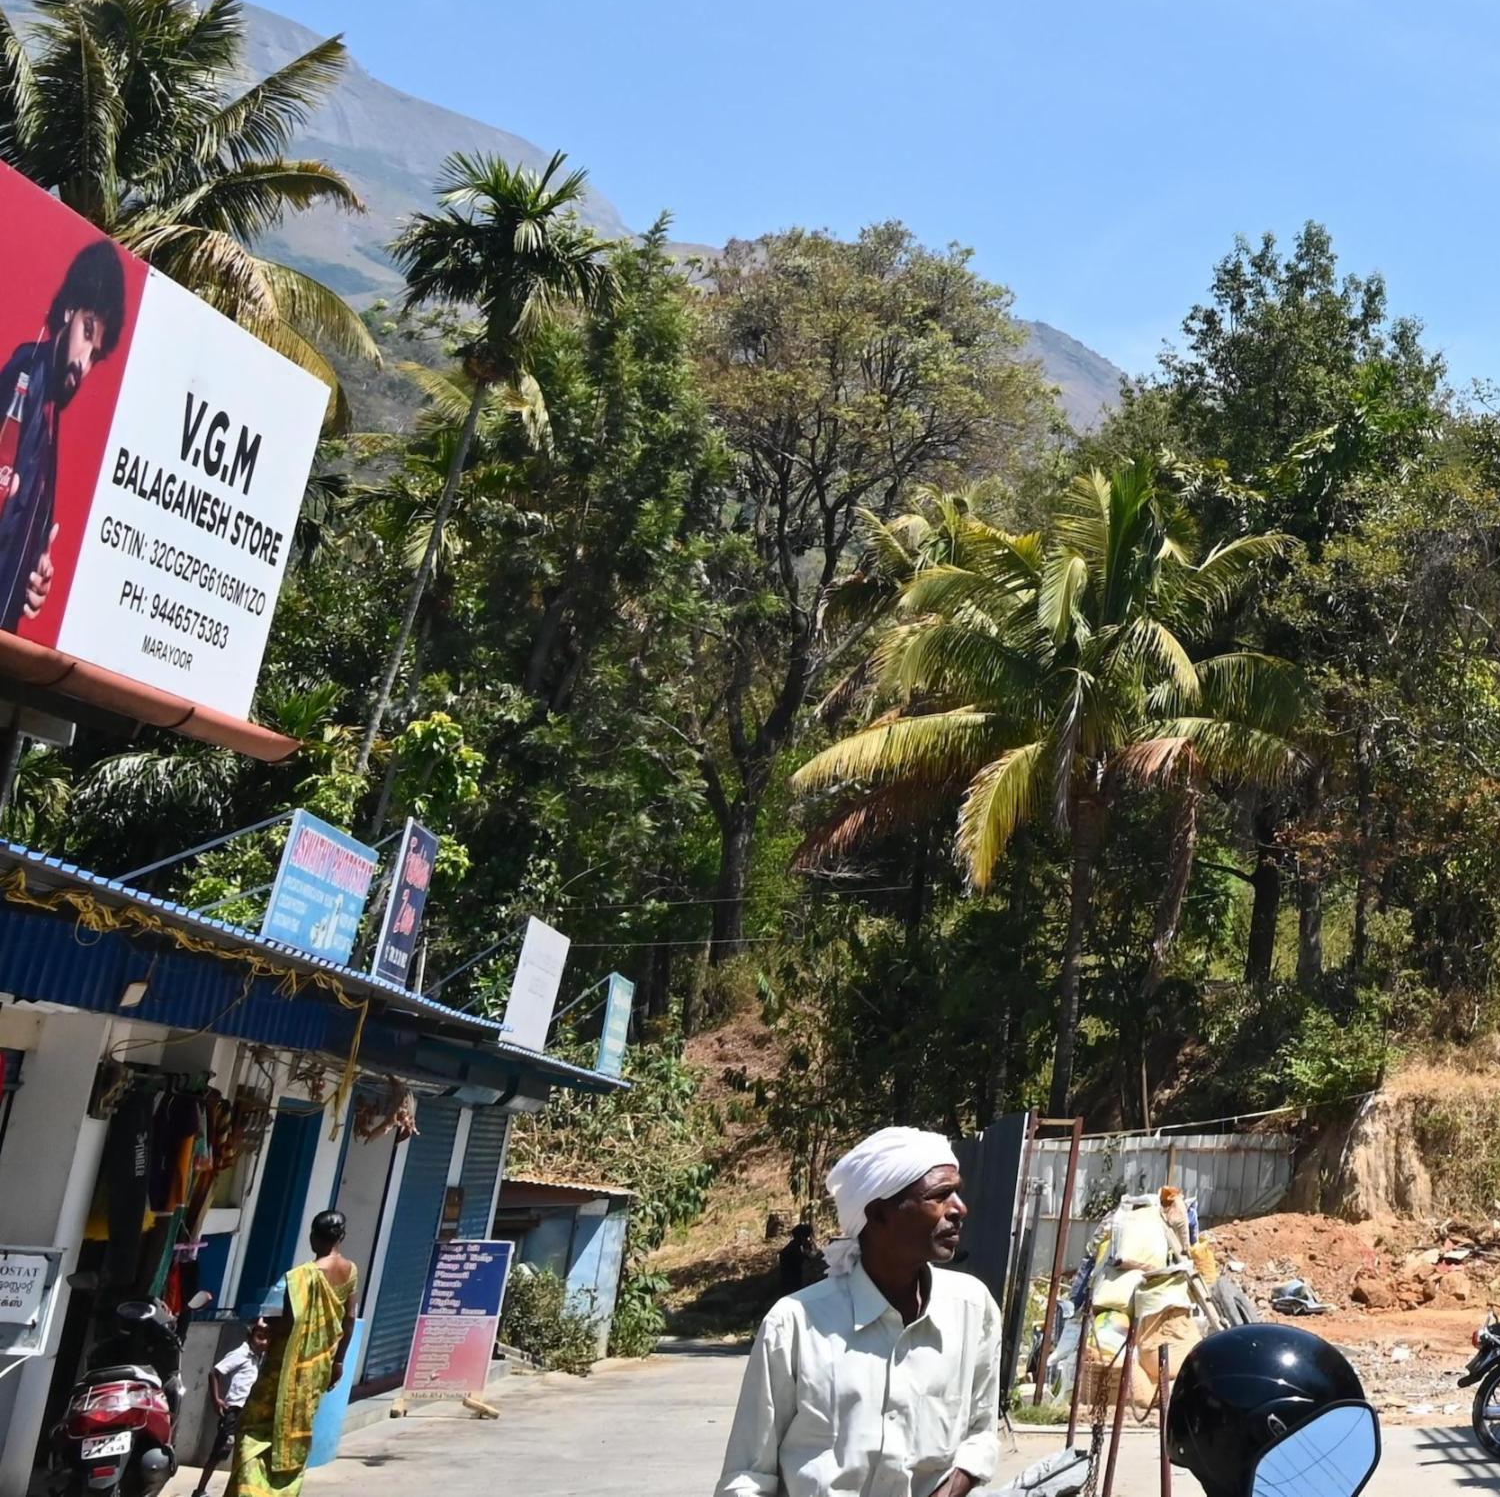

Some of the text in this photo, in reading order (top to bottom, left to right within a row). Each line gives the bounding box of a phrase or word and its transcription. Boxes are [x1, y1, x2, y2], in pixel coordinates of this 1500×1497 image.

[180, 391, 262, 496] V.G.M
[100, 516, 149, 561] GSTIN:
[112, 447, 283, 567] BALAGANESH STORE
[119, 580, 229, 649] PH: 9446575383
[141, 635, 193, 671] MARAYOOR
